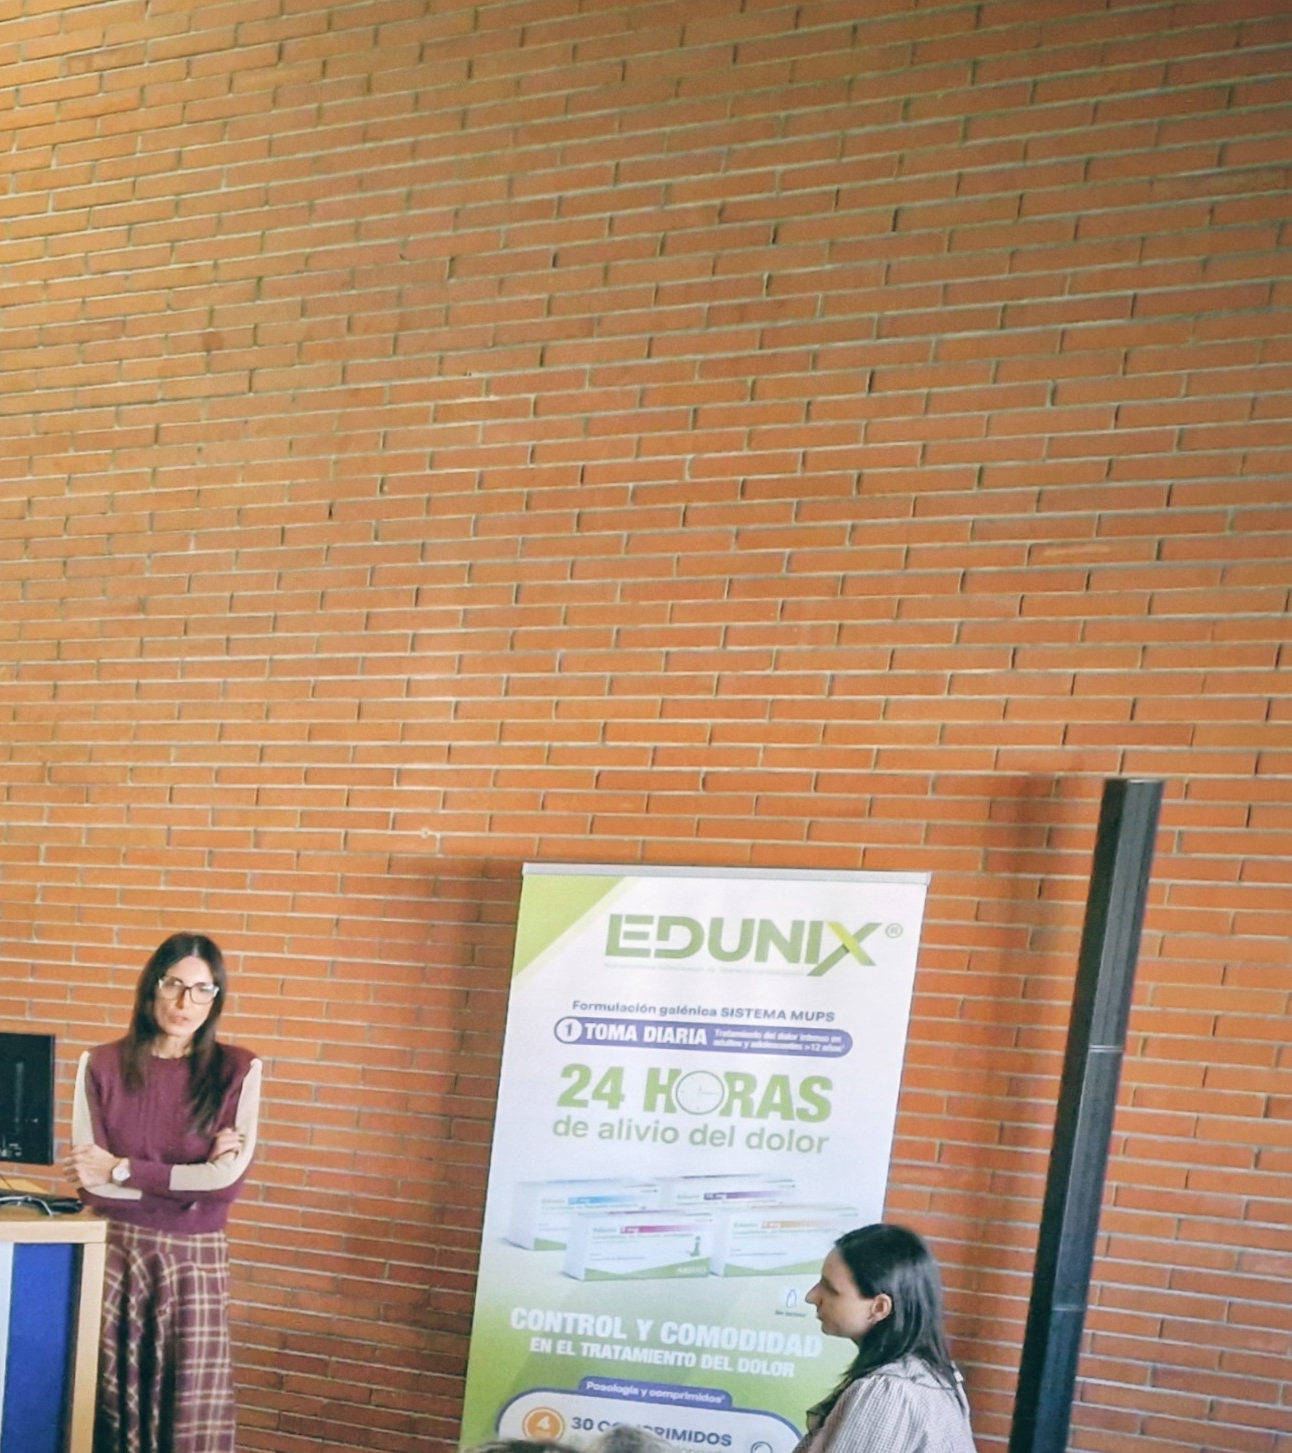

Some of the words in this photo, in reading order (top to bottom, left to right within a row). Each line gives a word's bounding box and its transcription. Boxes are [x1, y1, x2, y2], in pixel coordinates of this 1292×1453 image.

[572, 1000, 657, 1015] Formulación
[659, 1004, 717, 1017] galénica
[720, 1007, 786, 1020] SISTEMA
[790, 1010, 836, 1023] MUPS
[584, 1022, 638, 1042] TOMA
[643, 1025, 708, 1046] DIARIA
[556, 1063, 625, 1110] 24
[552, 1115, 589, 1138] de
[597, 1117, 680, 1145] alivio
[688, 1123, 736, 1148] del
[745, 1127, 830, 1154] dolor
[510, 1307, 627, 1340] CONTROL
[636, 1318, 654, 1342] Y
[660, 1320, 824, 1359] COMODIDAD
[529, 1337, 553, 1354] EN
[555, 1339, 576, 1356] EL
[579, 1341, 697, 1368] TRATAMIENTO
[701, 1353, 733, 1372] DEL
[737, 1357, 795, 1378] DOLOR
[586, 1380, 639, 1397] Posología
[640, 1388, 649, 1398] y
[537, 1415, 551, 1430] 4
[571, 1416, 594, 1431] 30
[597, 1420, 733, 1447] CRIMIDOS
